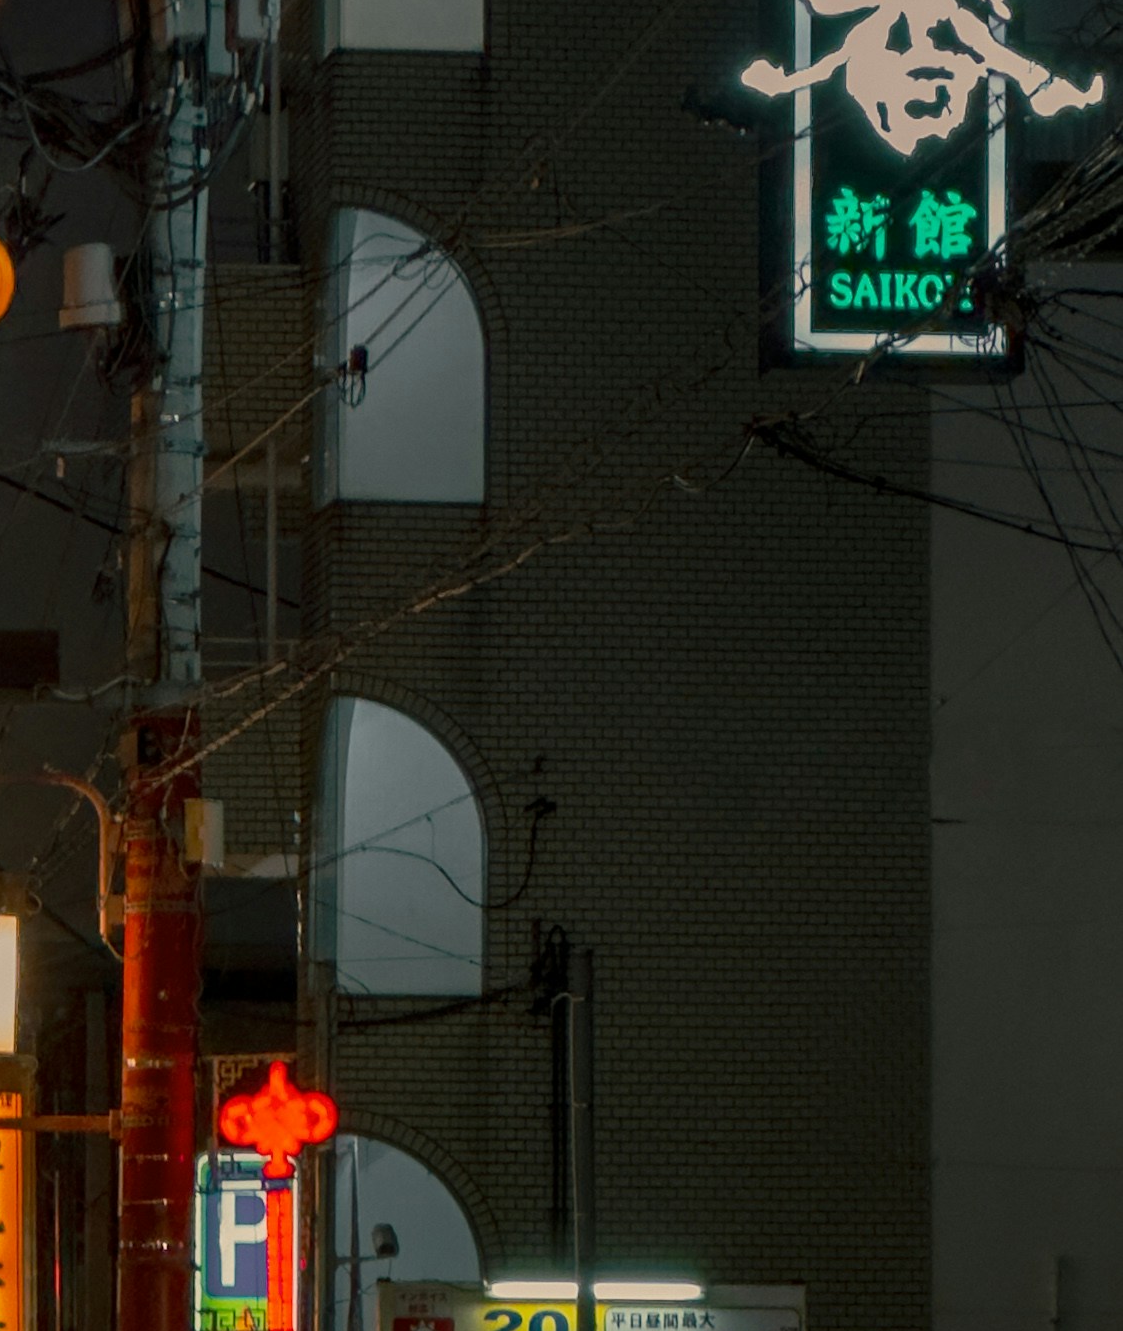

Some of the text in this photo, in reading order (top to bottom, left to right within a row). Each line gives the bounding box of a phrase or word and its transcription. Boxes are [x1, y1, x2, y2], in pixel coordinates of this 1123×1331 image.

[825, 187, 977, 262] 新館
[830, 271, 974, 312] SAIKO
[219, 1180, 269, 1288] P
[611, 1311, 715, 1330] 平日昼間最大
